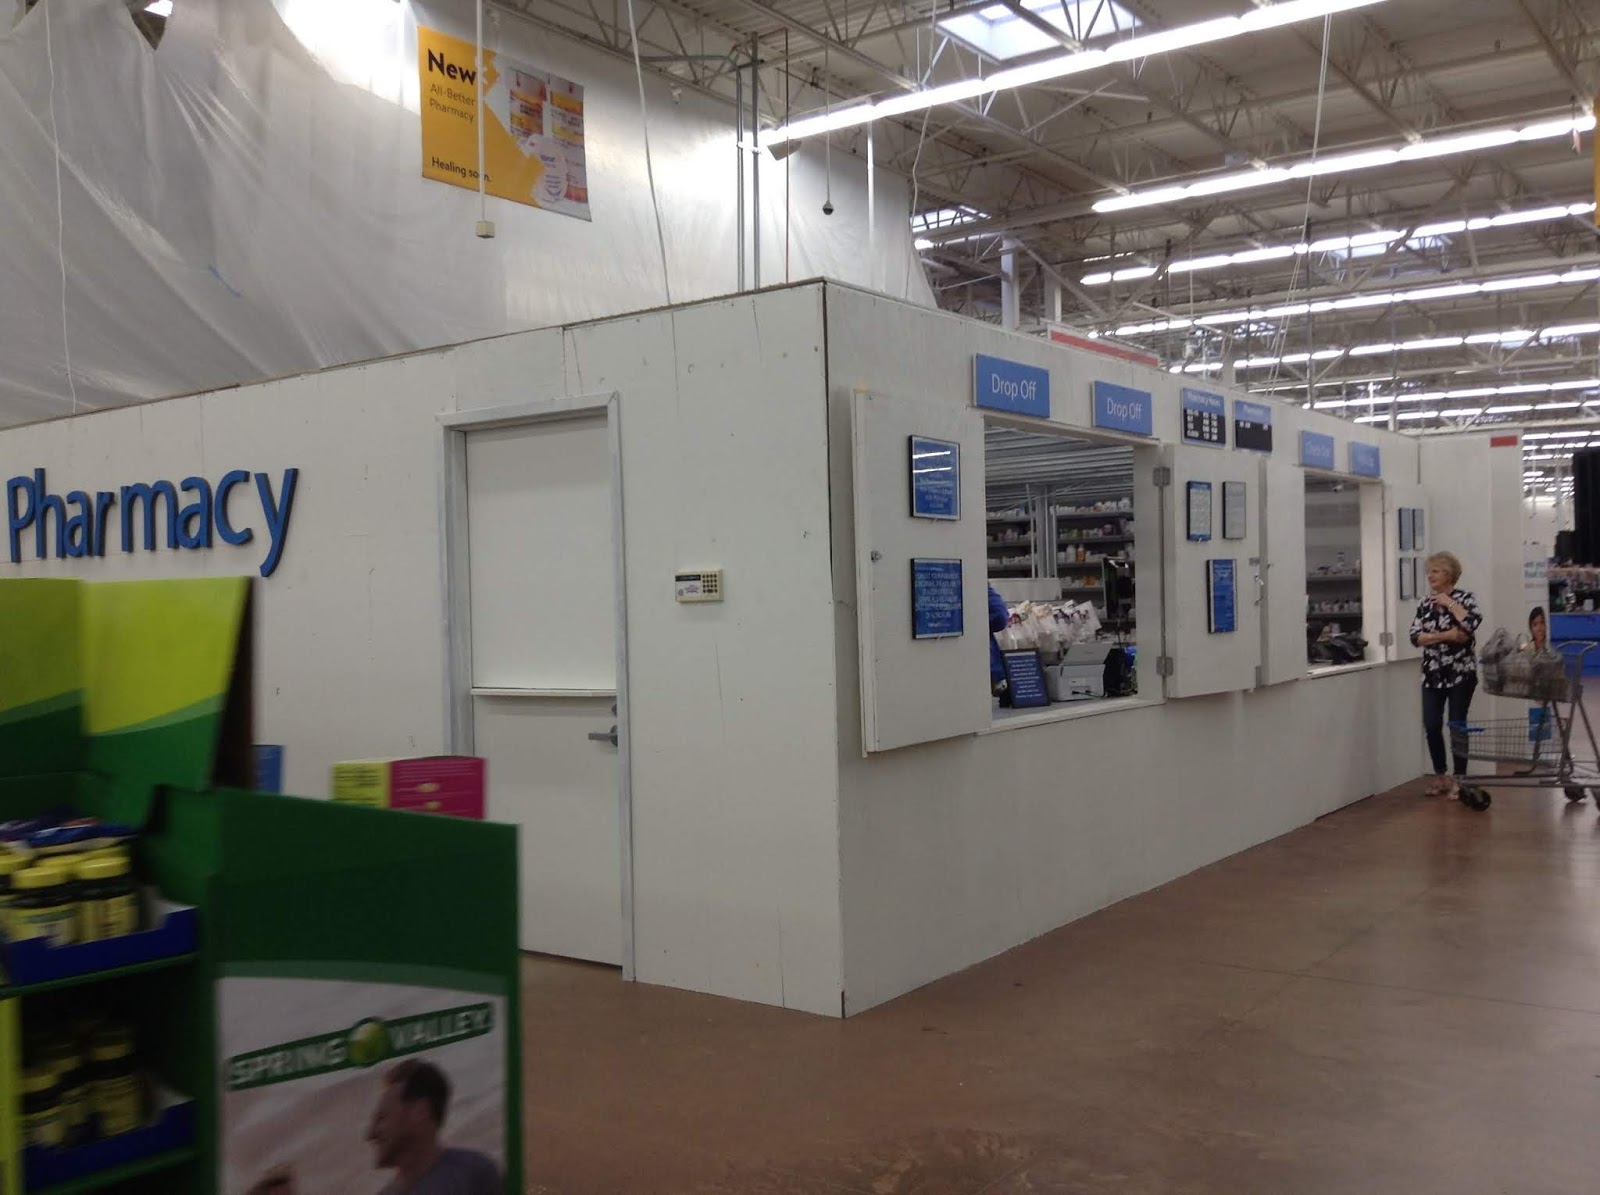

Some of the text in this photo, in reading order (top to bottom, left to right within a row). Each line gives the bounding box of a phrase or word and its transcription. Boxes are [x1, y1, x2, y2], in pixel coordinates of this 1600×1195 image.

[427, 48, 477, 86] New
[430, 83, 475, 106] All-Better
[429, 98, 474, 124] Pharmacy
[431, 156, 492, 182] Healing son.
[992, 373, 1037, 401] Drop Off
[1106, 397, 1142, 422] Drop Off
[7, 468, 298, 577] Pharmacy
[228, 1009, 493, 1086] SPRING VALLEY
